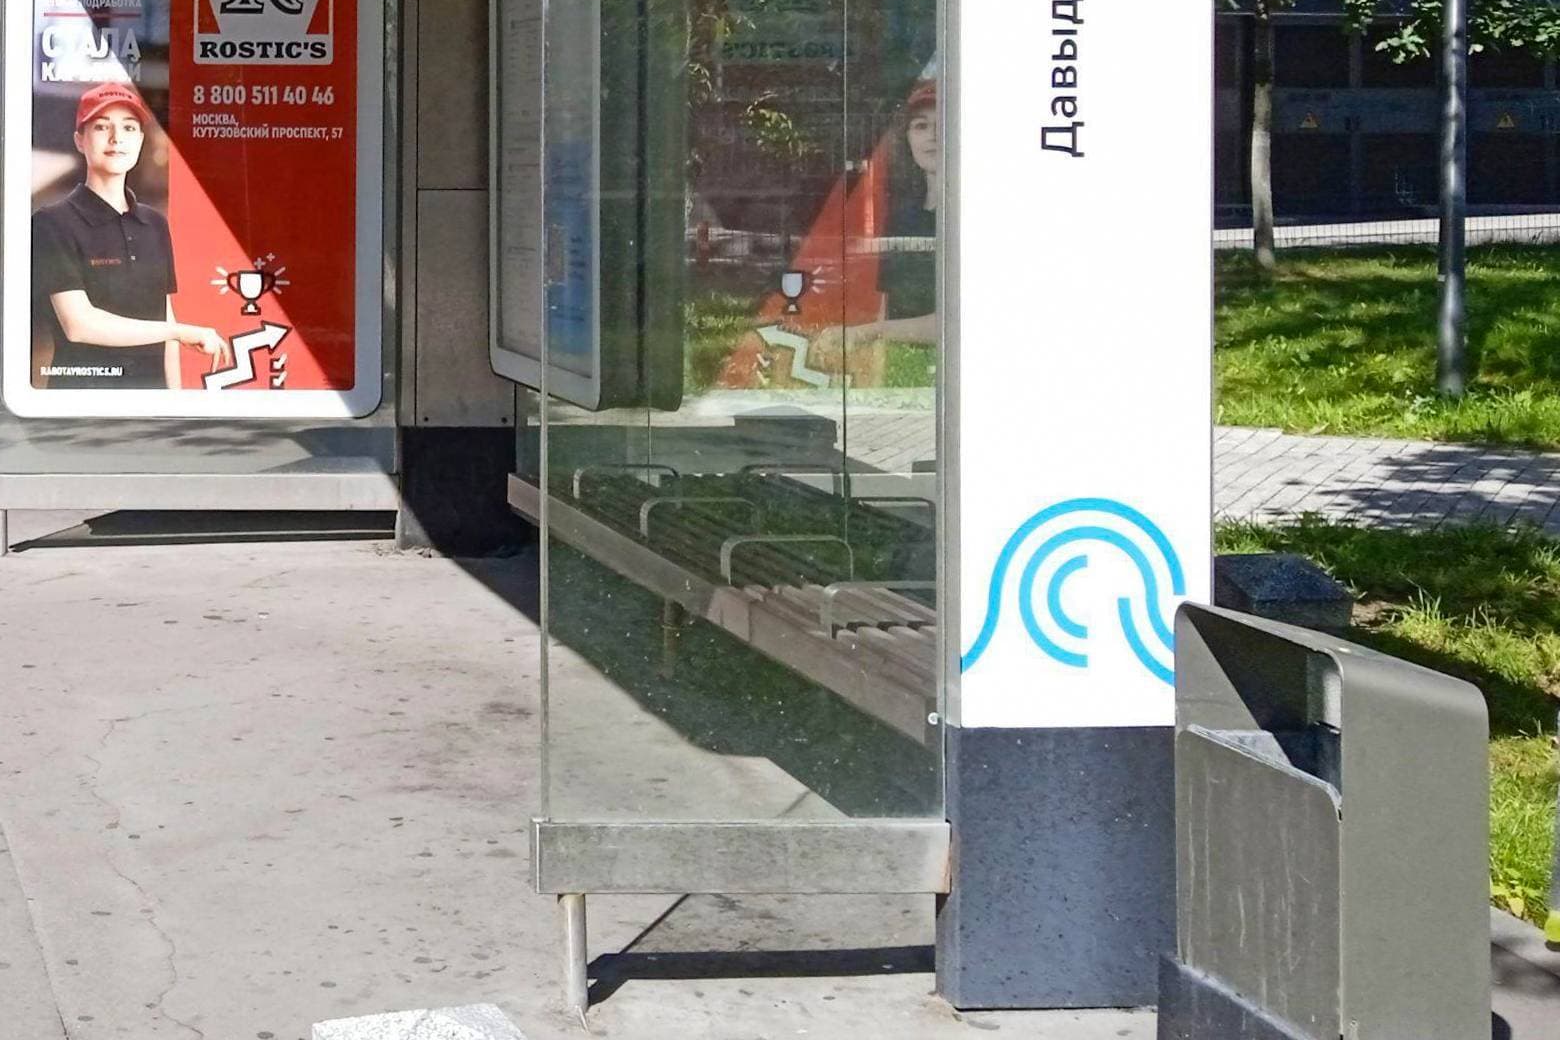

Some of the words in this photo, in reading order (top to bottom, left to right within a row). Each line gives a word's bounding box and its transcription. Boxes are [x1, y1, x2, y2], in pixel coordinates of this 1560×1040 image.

[42, 27, 141, 59] САЛА
[200, 41, 327, 58] ROSTIC'S
[193, 85, 205, 105] 8
[210, 85, 246, 105] 800
[251, 85, 278, 105] 511
[282, 85, 307, 105] 40
[311, 85, 335, 105] 46
[192, 114, 239, 127] МОСКВА,
[192, 123, 269, 138] КУТУЗОВСКИЙ
[271, 127, 329, 140] ПРОСПЕКТ,
[331, 127, 343, 138] 57
